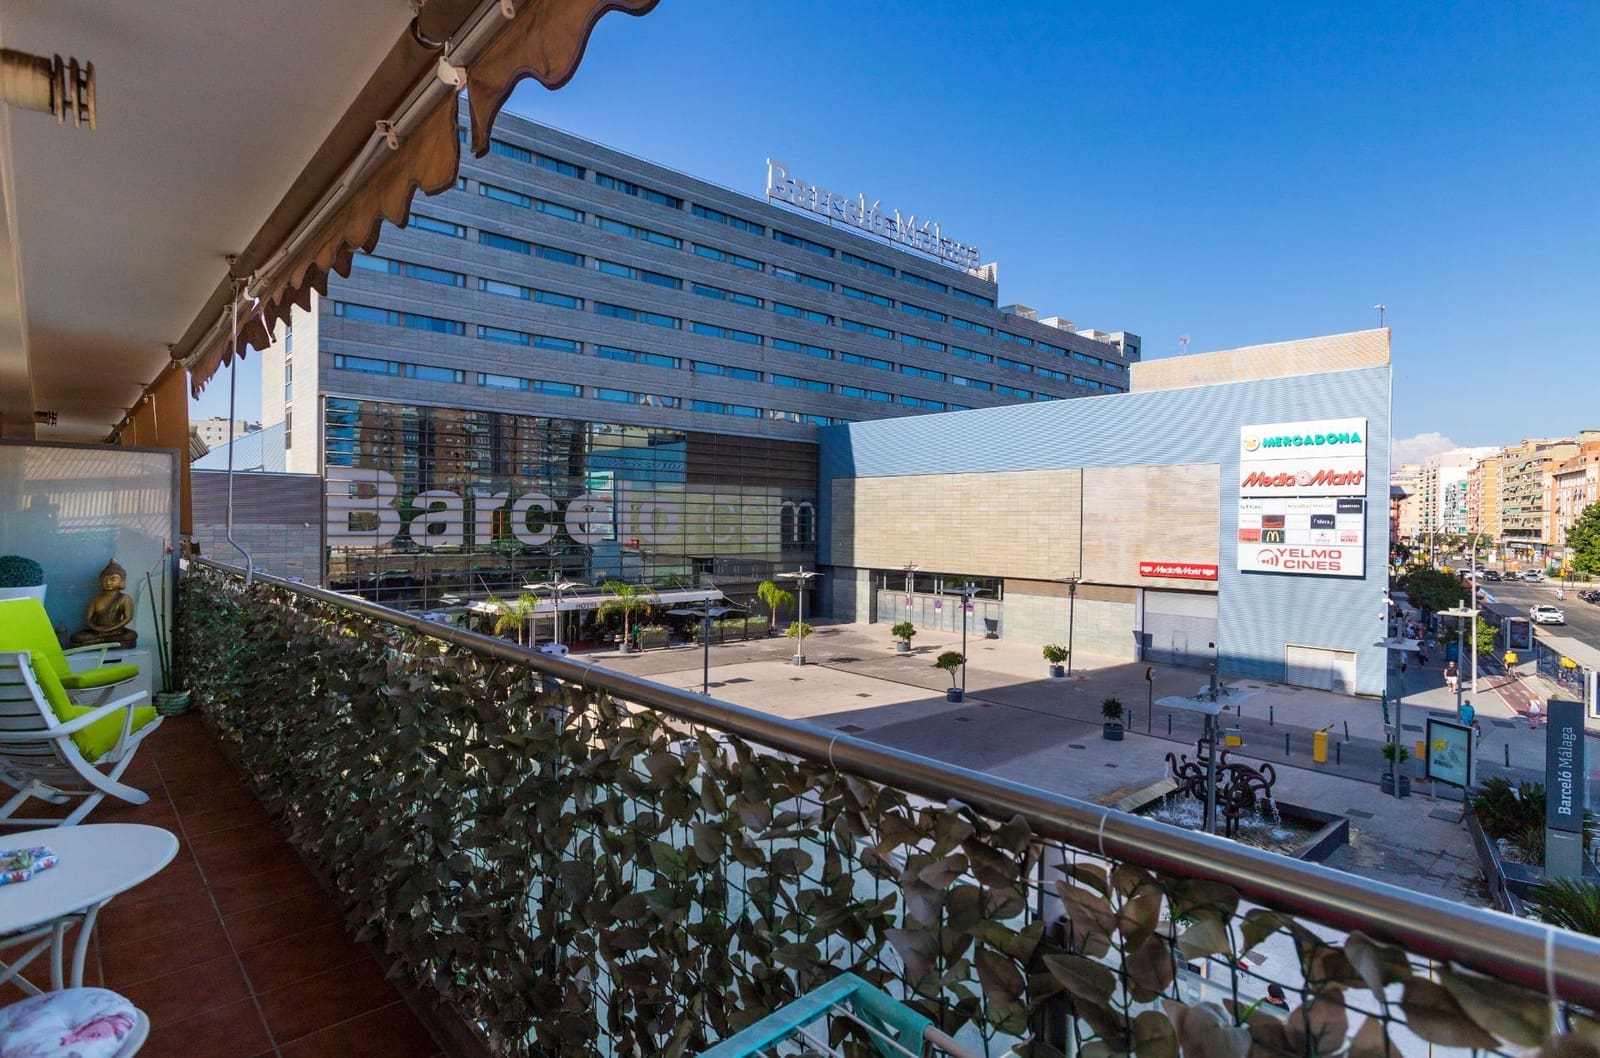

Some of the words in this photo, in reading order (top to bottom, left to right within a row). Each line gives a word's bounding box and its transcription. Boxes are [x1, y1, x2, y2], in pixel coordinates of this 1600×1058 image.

[1262, 432, 1362, 448] MERCADONA
[1241, 471, 1296, 488] Media
[1308, 469, 1364, 486] Markt
[1276, 548, 1342, 560] YELMO
[1283, 559, 1341, 571] CINES
[1558, 727, 1577, 769] Málaga
[1558, 770, 1572, 816] Barceló
